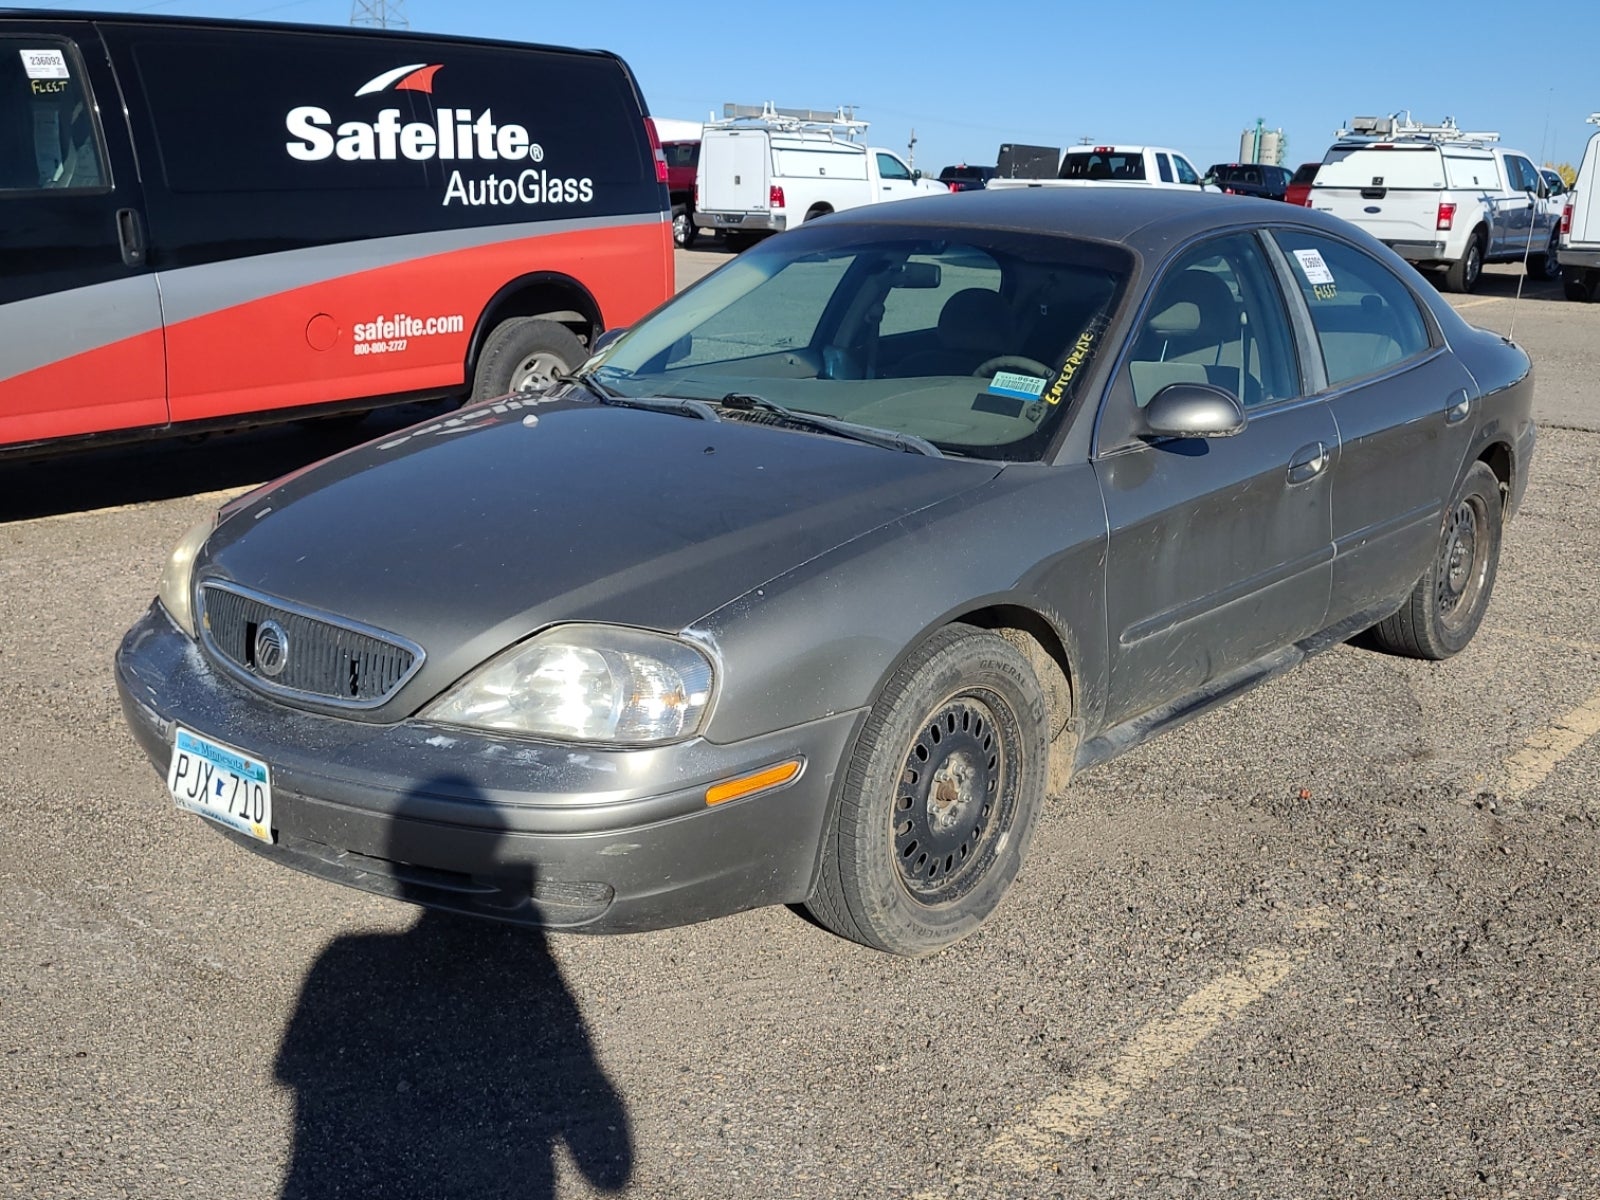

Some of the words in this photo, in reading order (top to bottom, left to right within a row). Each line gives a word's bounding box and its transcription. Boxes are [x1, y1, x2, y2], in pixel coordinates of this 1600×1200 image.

[29, 56, 62, 65] 236092
[31, 80, 68, 95] FLEET
[442, 169, 594, 206] AutoGlass
[353, 313, 463, 341] safelite.com
[354, 340, 407, 355] 800-800-2727
[980, 659, 1026, 688] GENERAL
[200, 742, 243, 770] Minnesota
[173, 753, 214, 805] PJX
[228, 772, 264, 824] 710
